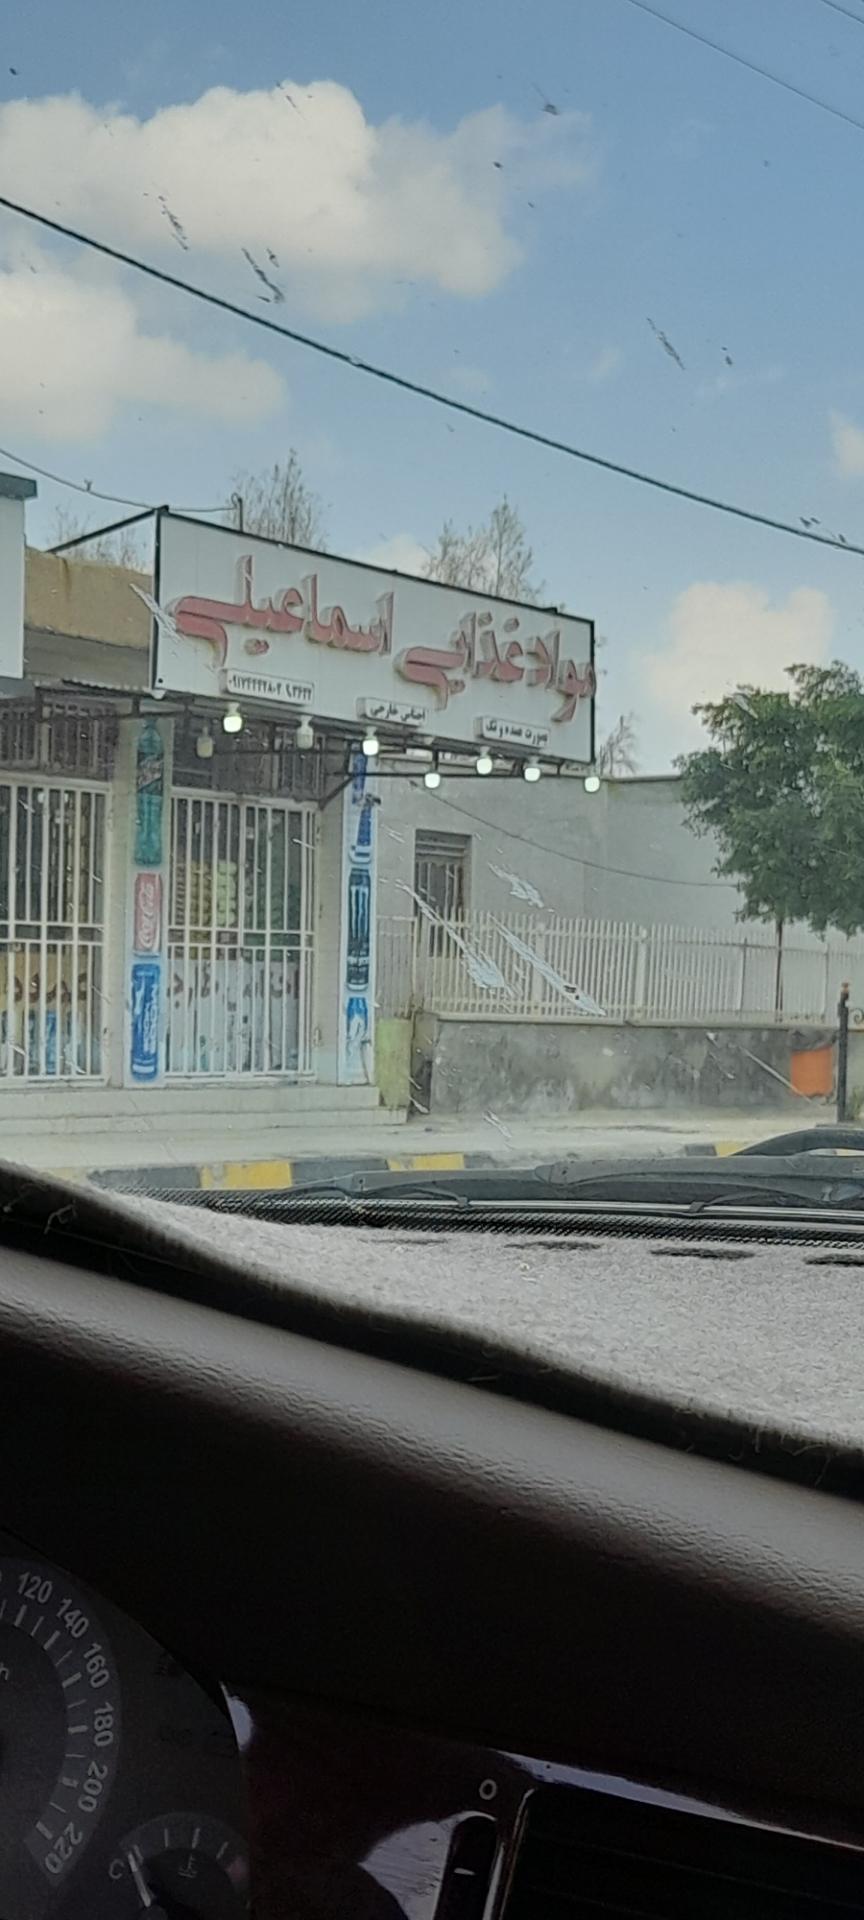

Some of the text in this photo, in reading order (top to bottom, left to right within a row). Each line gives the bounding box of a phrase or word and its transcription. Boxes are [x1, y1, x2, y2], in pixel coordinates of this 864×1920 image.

[170, 555, 396, 667] اسماعیلی
[525, 629, 597, 723] مواد
[18, 1571, 53, 1604] 120
[56, 1598, 89, 1639] 140
[83, 1642, 110, 1689] 160
[93, 1701, 115, 1747] 180
[77, 1760, 108, 1813] 200
[45, 1821, 83, 1874] 220
[109, 1858, 125, 1879] C
